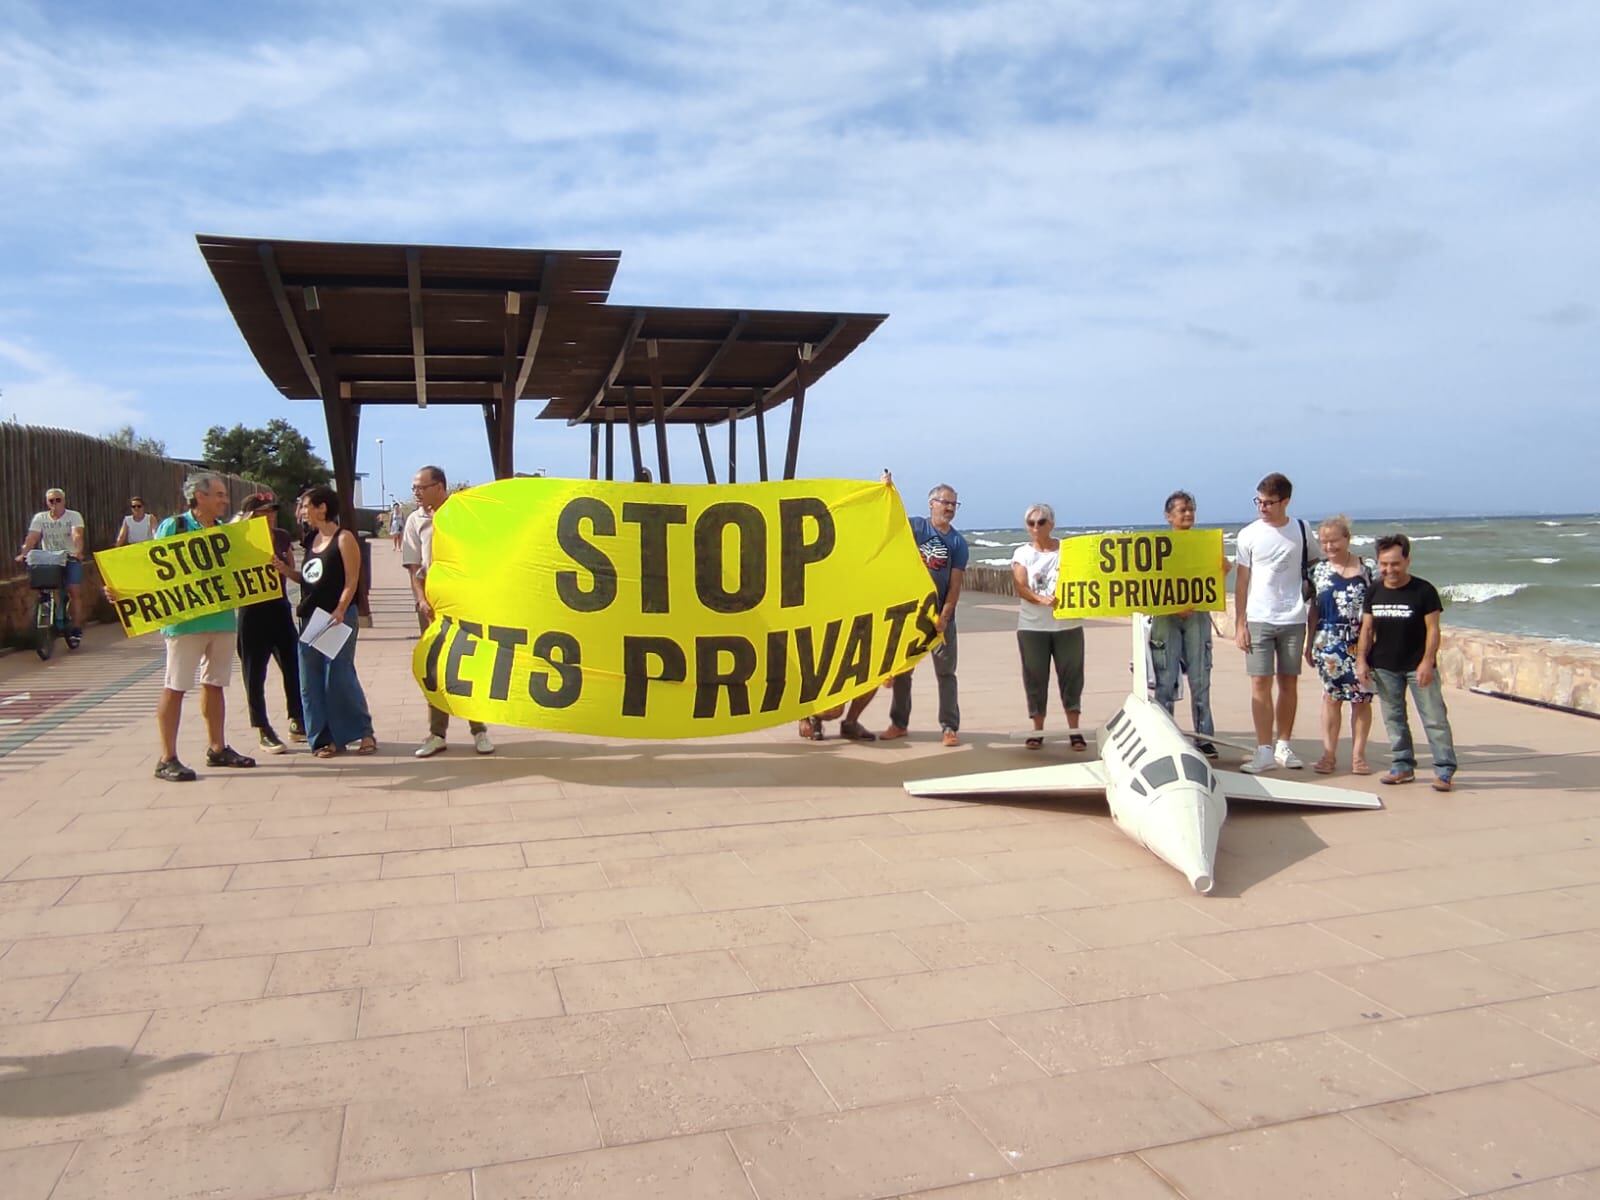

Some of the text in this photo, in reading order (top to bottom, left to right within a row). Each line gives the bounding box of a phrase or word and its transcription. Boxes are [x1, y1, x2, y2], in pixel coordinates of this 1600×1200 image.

[149, 532, 231, 581] STOP
[555, 497, 837, 614] STOP
[1100, 536, 1173, 573] STOP
[117, 564, 278, 628] PRIVATE JETS
[1060, 576, 1217, 610] JETS PRIVADOS
[422, 590, 938, 719] JETS PRIVATS
